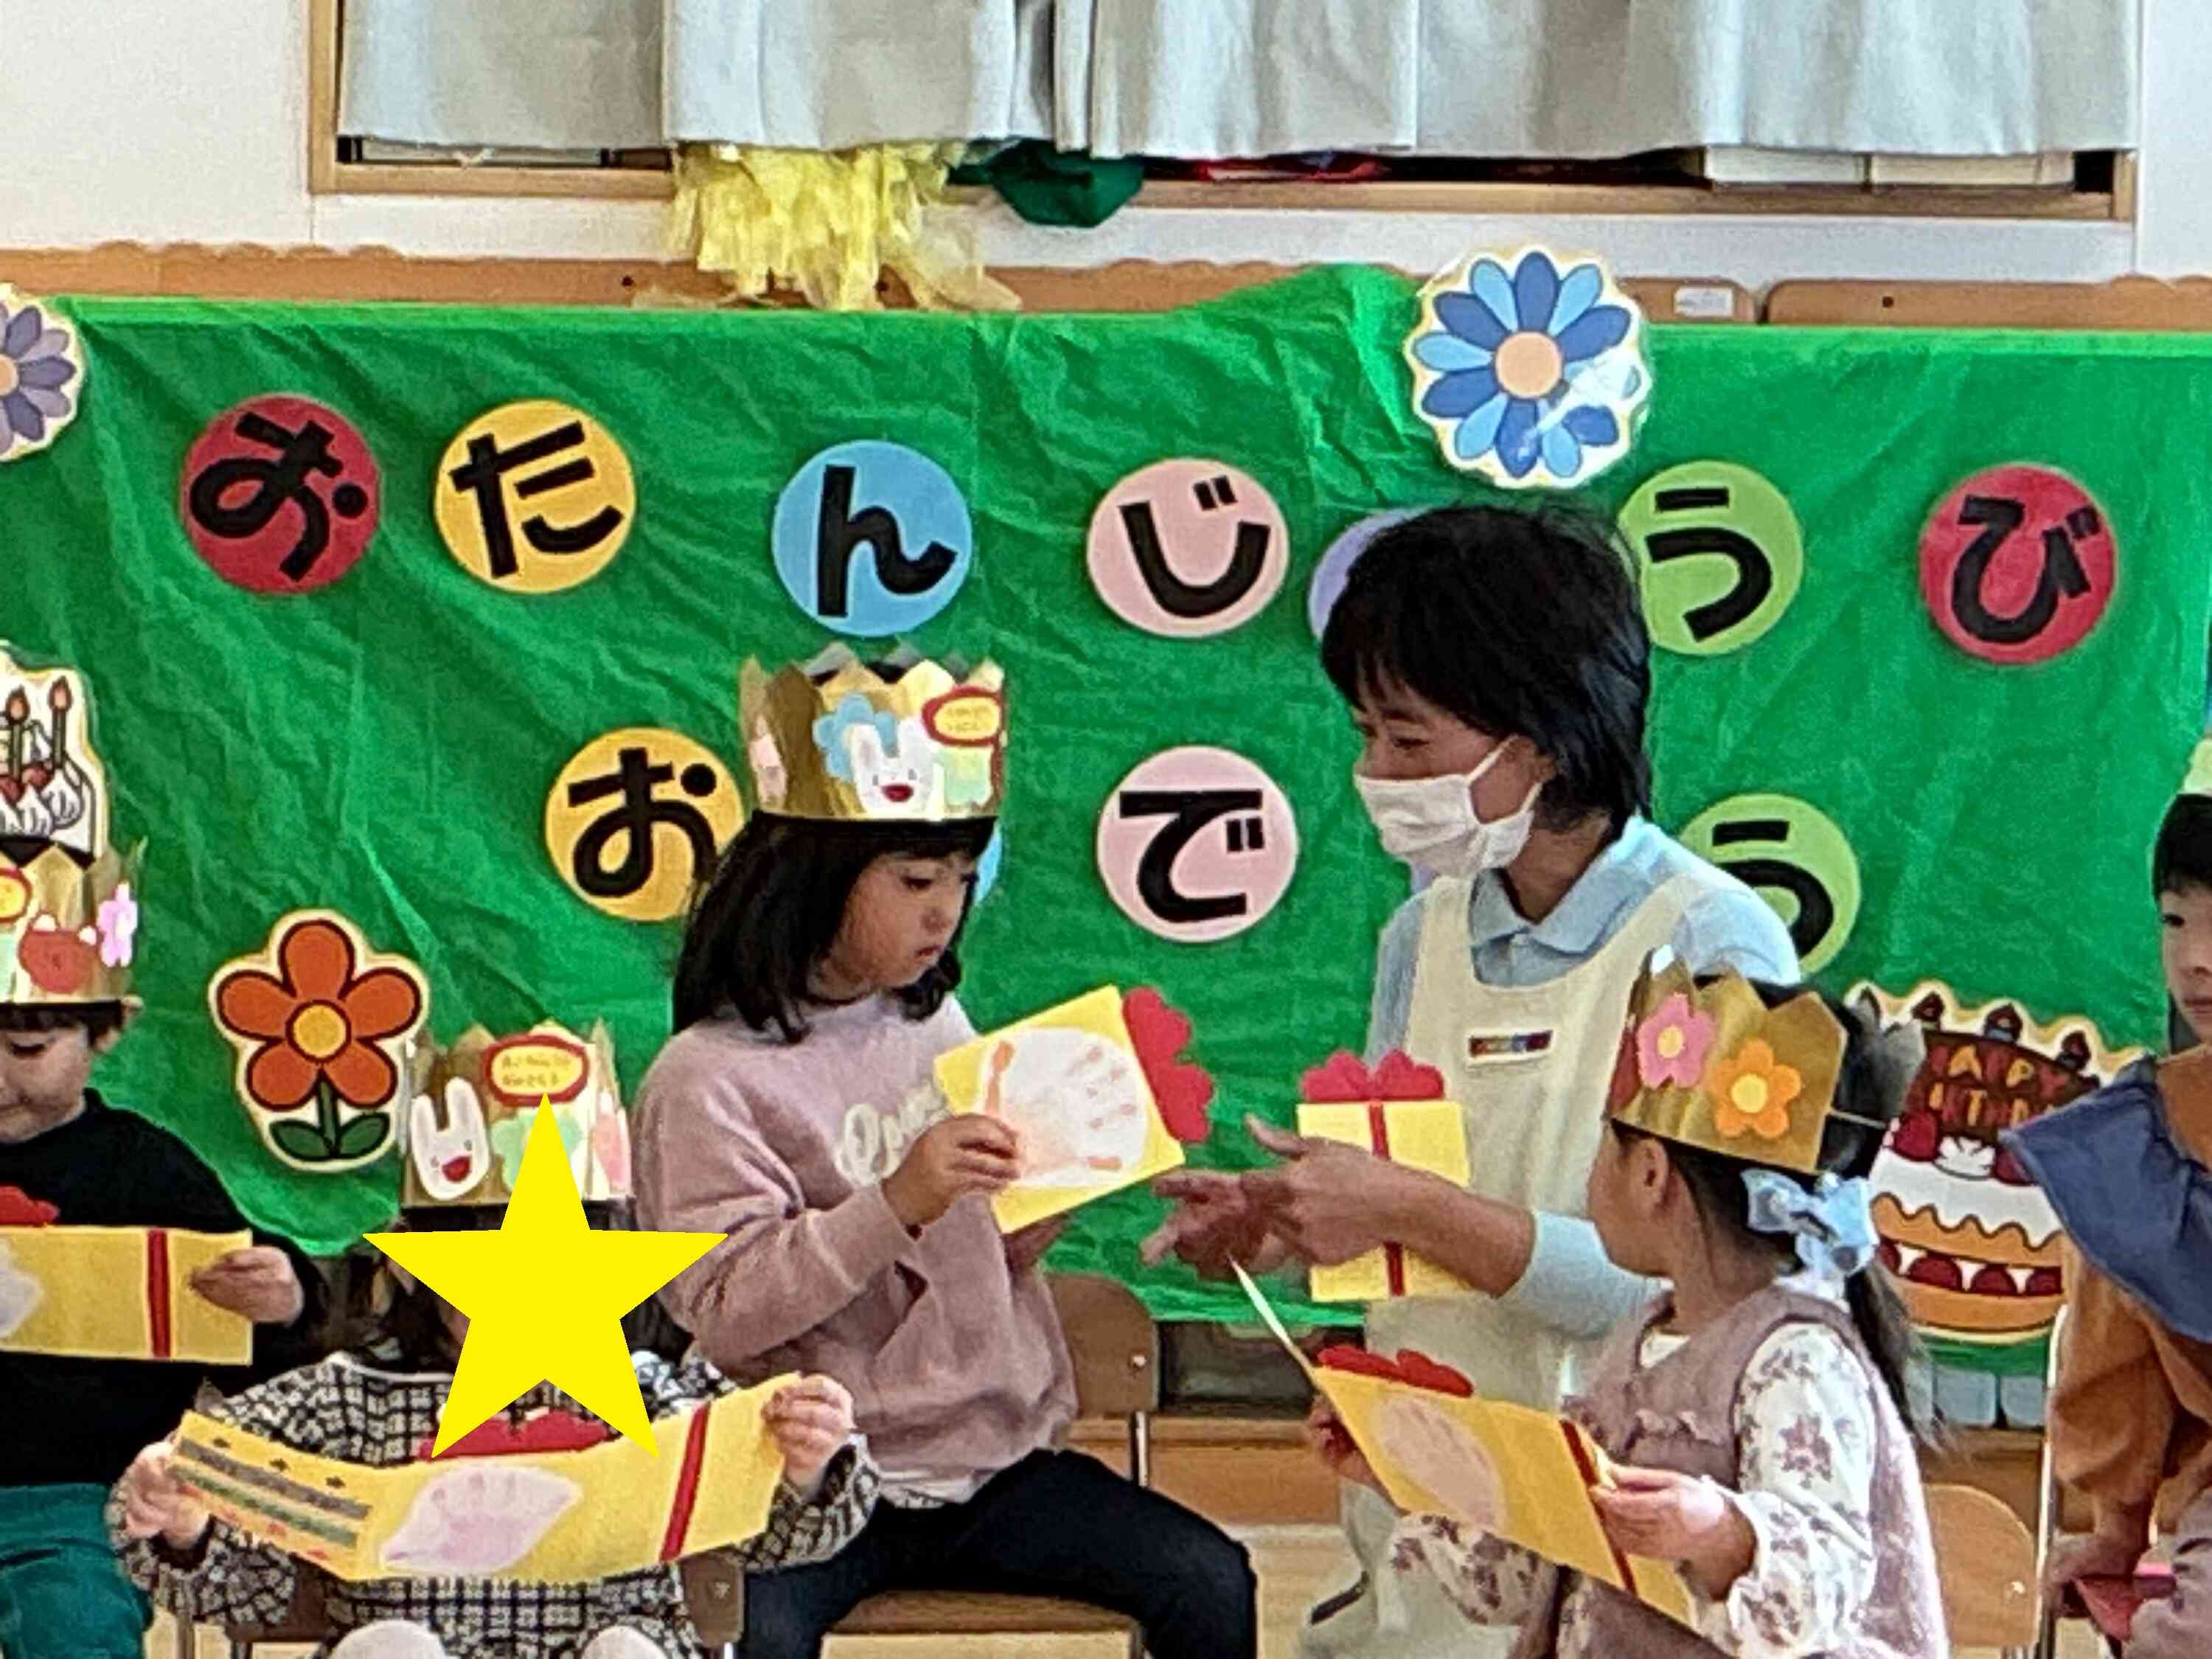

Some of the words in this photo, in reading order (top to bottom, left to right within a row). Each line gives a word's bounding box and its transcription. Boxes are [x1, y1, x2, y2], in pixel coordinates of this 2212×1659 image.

[189, 411, 2101, 644] おたんじうび
[568, 748, 1834, 954] おでう
